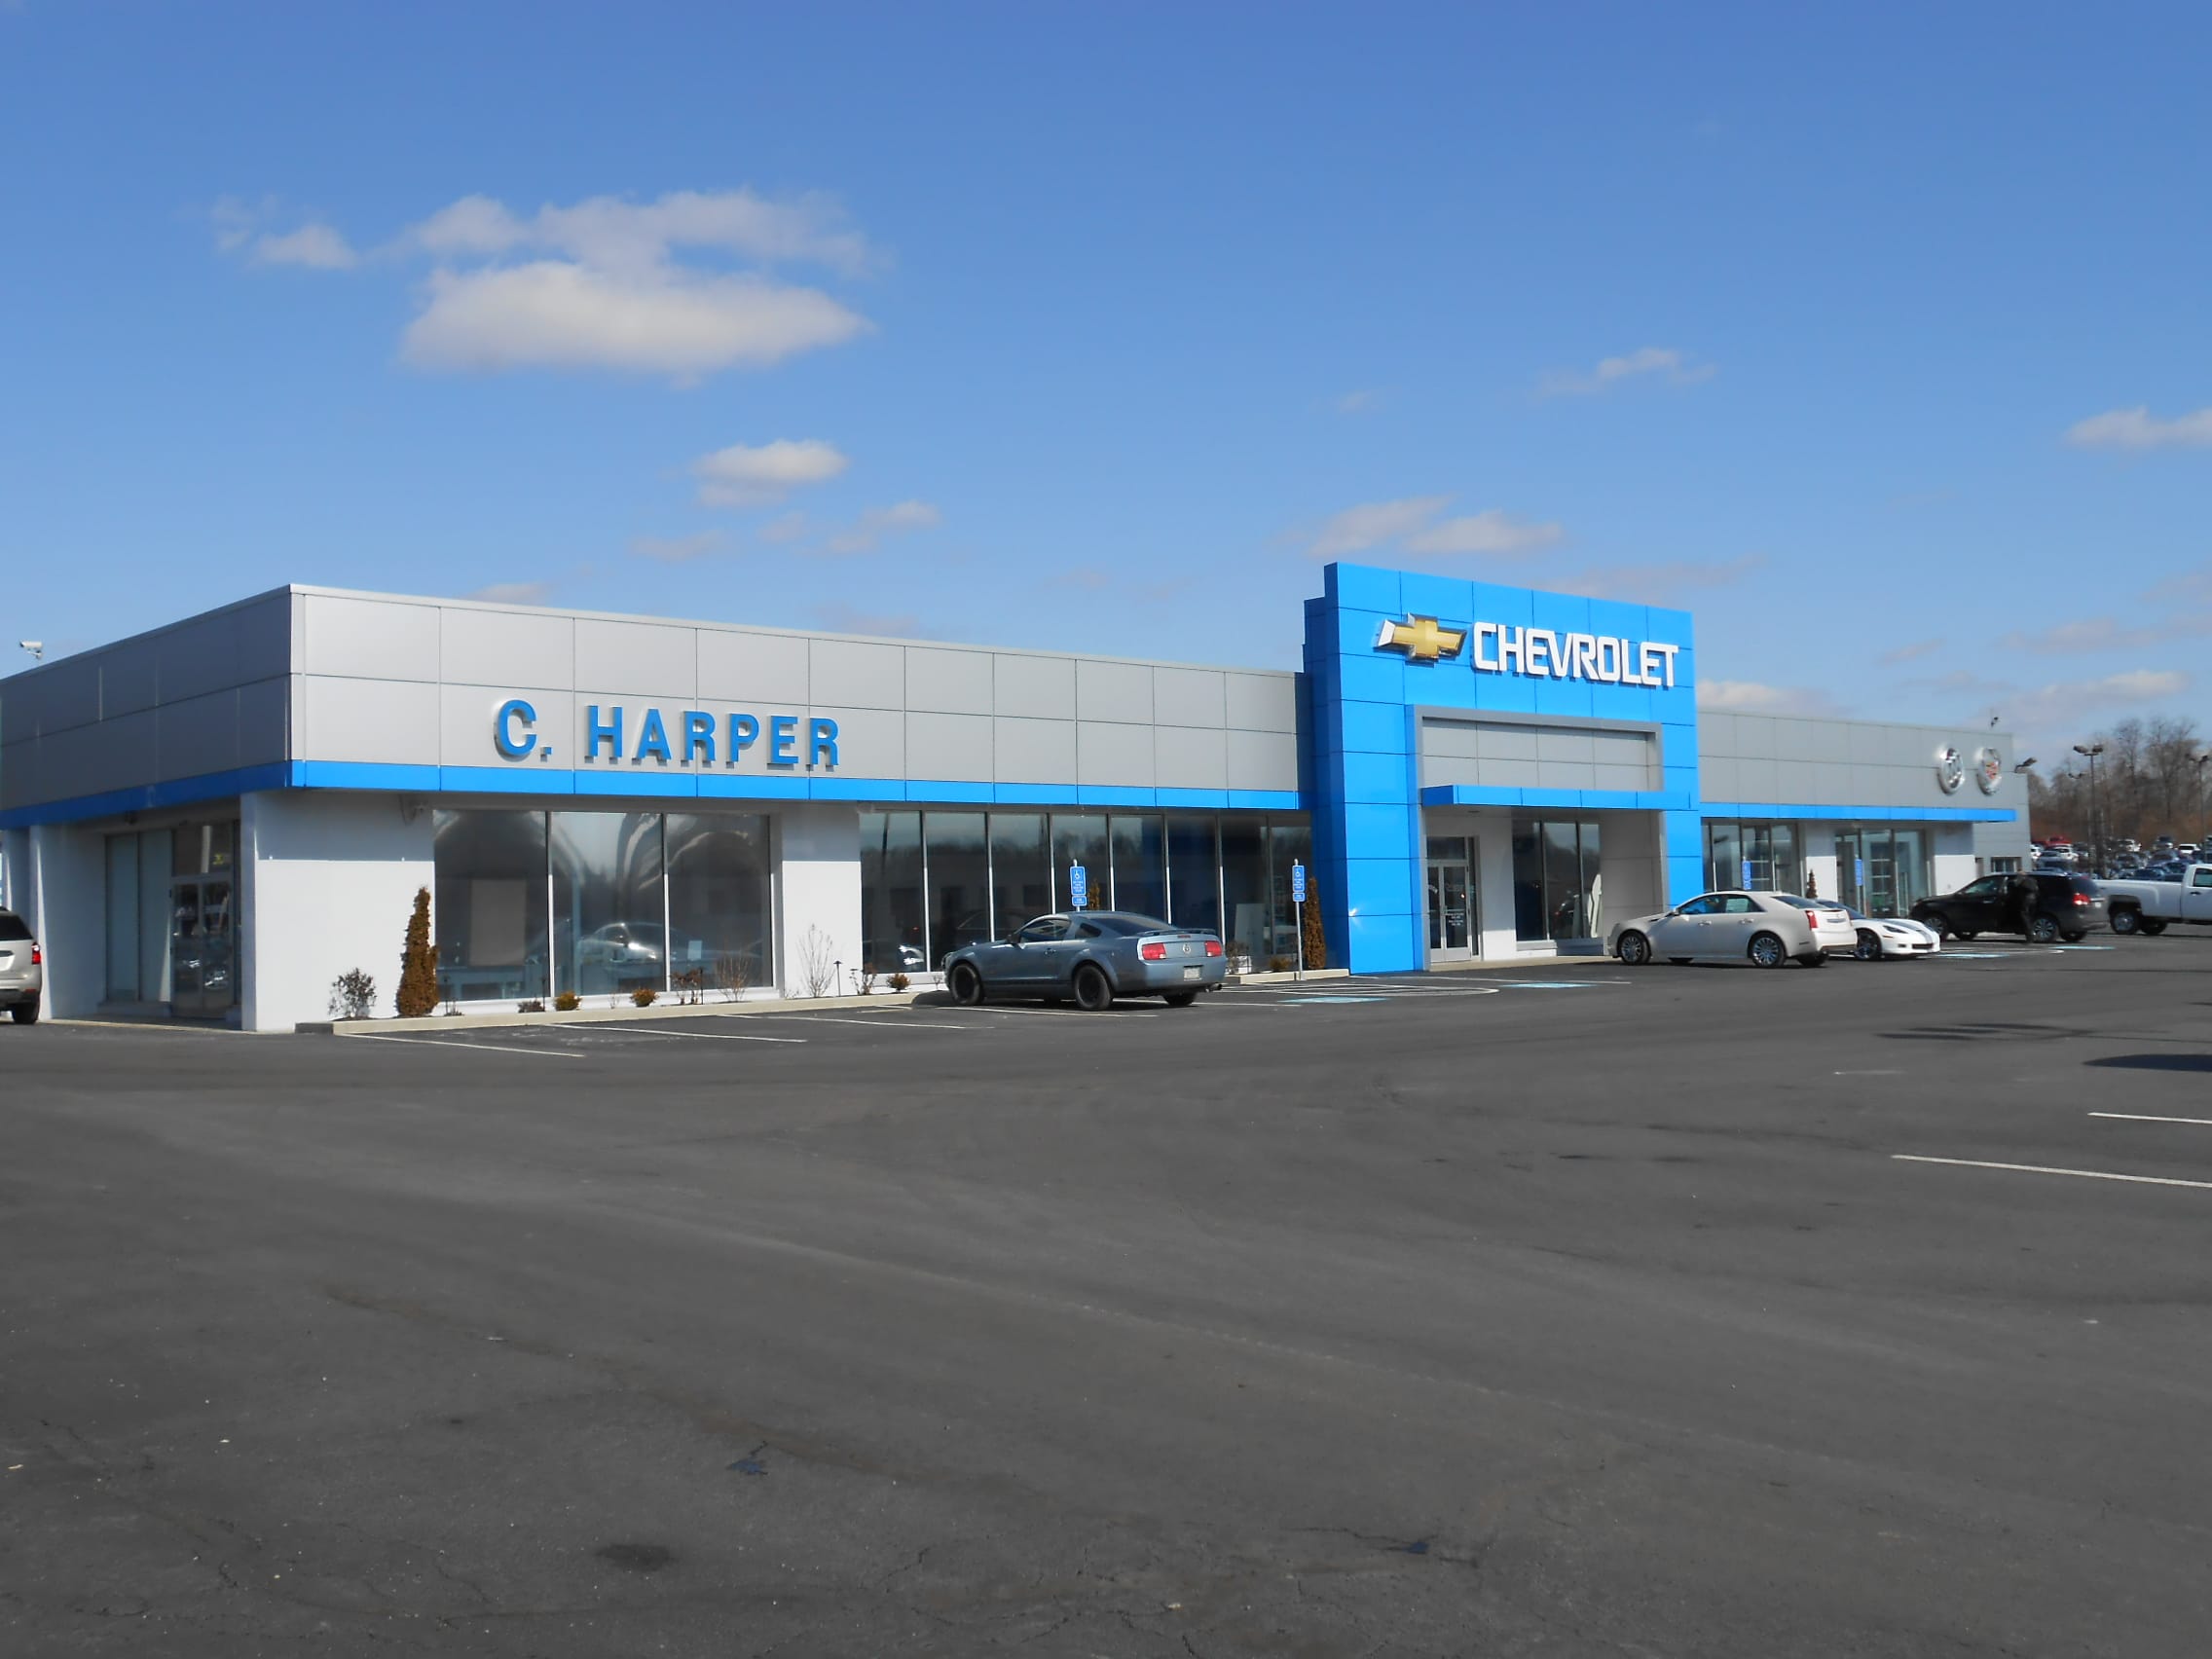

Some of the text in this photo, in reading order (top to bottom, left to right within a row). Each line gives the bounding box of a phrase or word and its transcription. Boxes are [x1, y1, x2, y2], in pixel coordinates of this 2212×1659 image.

[1473, 621, 1679, 687] CHEVROLET
[496, 699, 839, 767] C. HARPER
